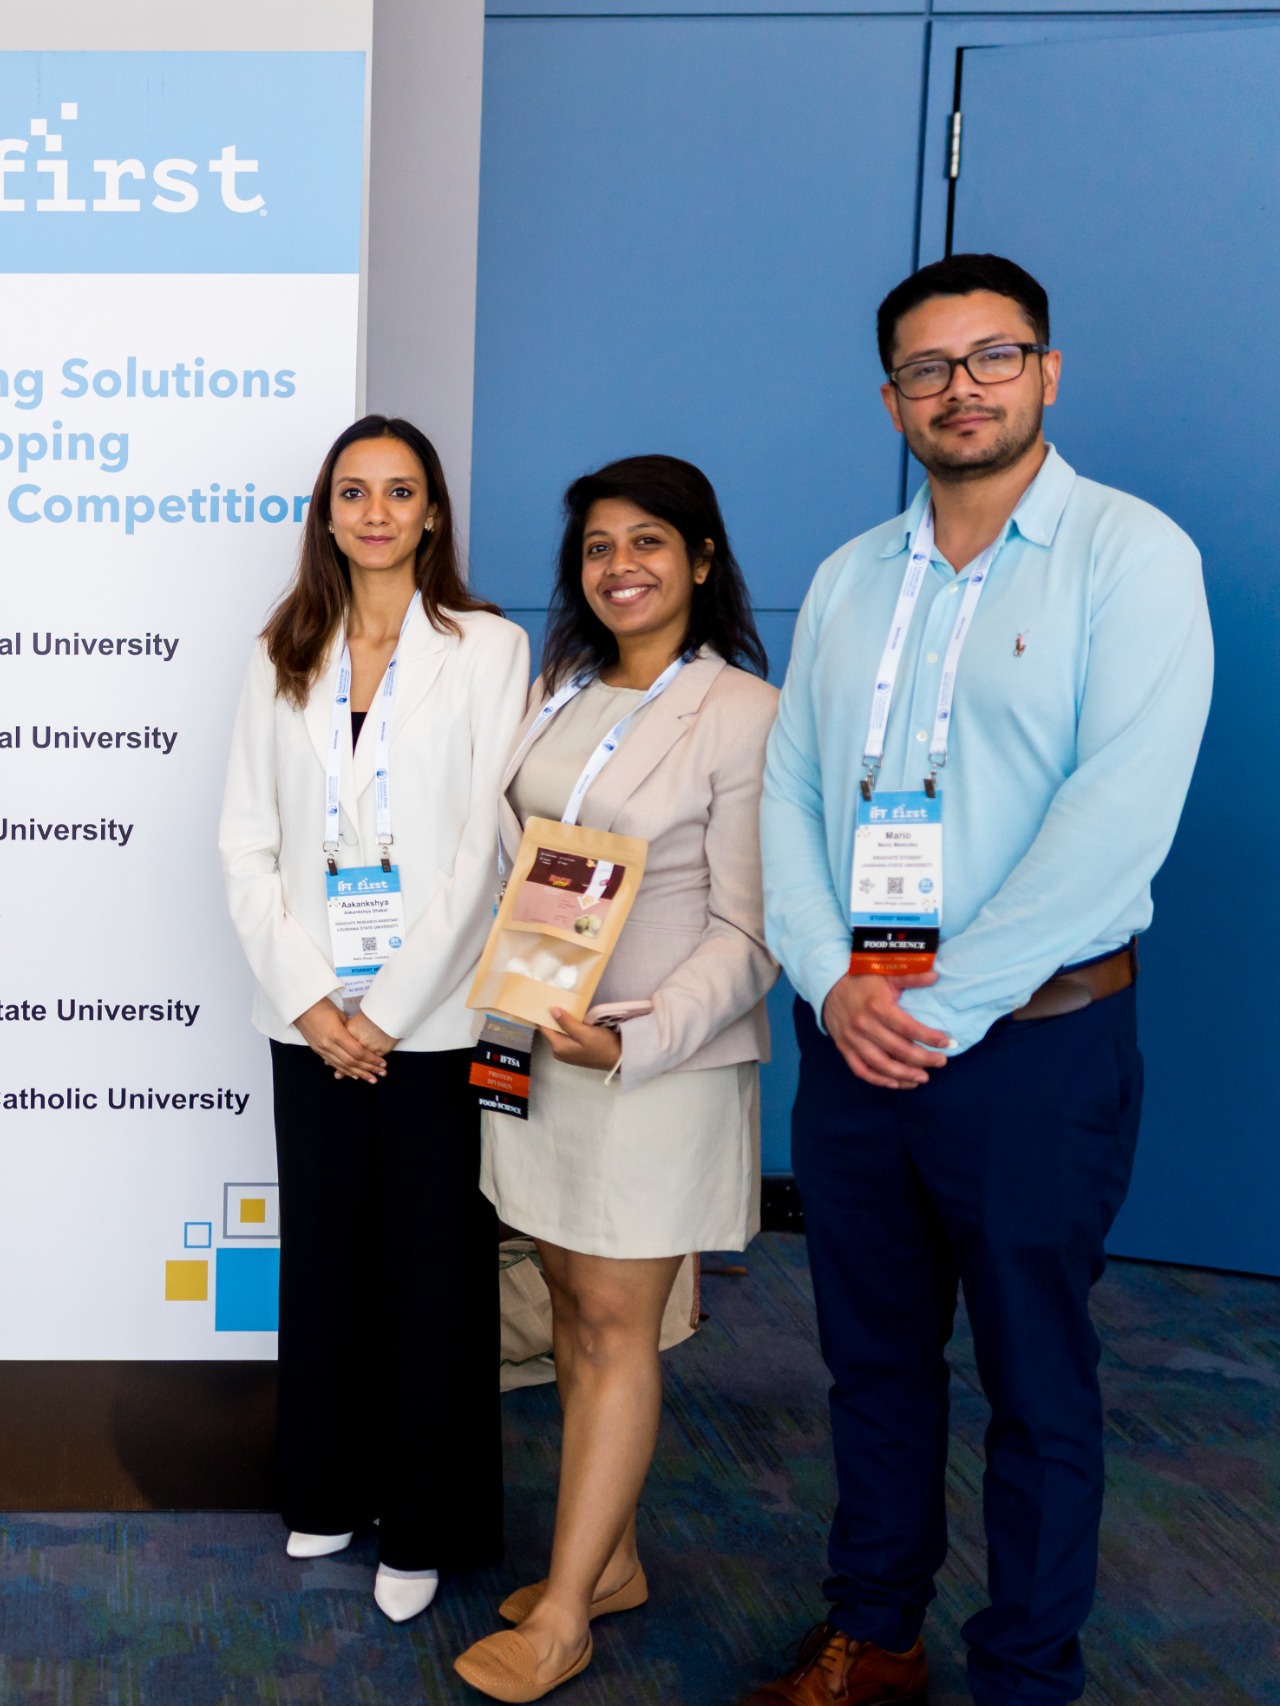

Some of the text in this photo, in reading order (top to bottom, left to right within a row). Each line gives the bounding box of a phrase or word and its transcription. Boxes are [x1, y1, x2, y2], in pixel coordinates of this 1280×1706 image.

[60, 356, 297, 398] Solutions
[32, 632, 180, 662] University
[32, 726, 179, 755] University
[892, 805, 928, 818] first
[338, 879, 389, 892] IFT first
[341, 900, 389, 908] Aakankshya
[863, 940, 926, 949] FOOD SCIENCE
[887, 933, 892, 941] I
[56, 998, 201, 1027] University
[486, 1051, 520, 1068] I IFTSA
[488, 1070, 513, 1082] PROTEIN
[487, 1078, 513, 1090] DIVISION
[107, 1086, 251, 1116] University
[479, 1098, 522, 1115] FOOD SCIENCE
